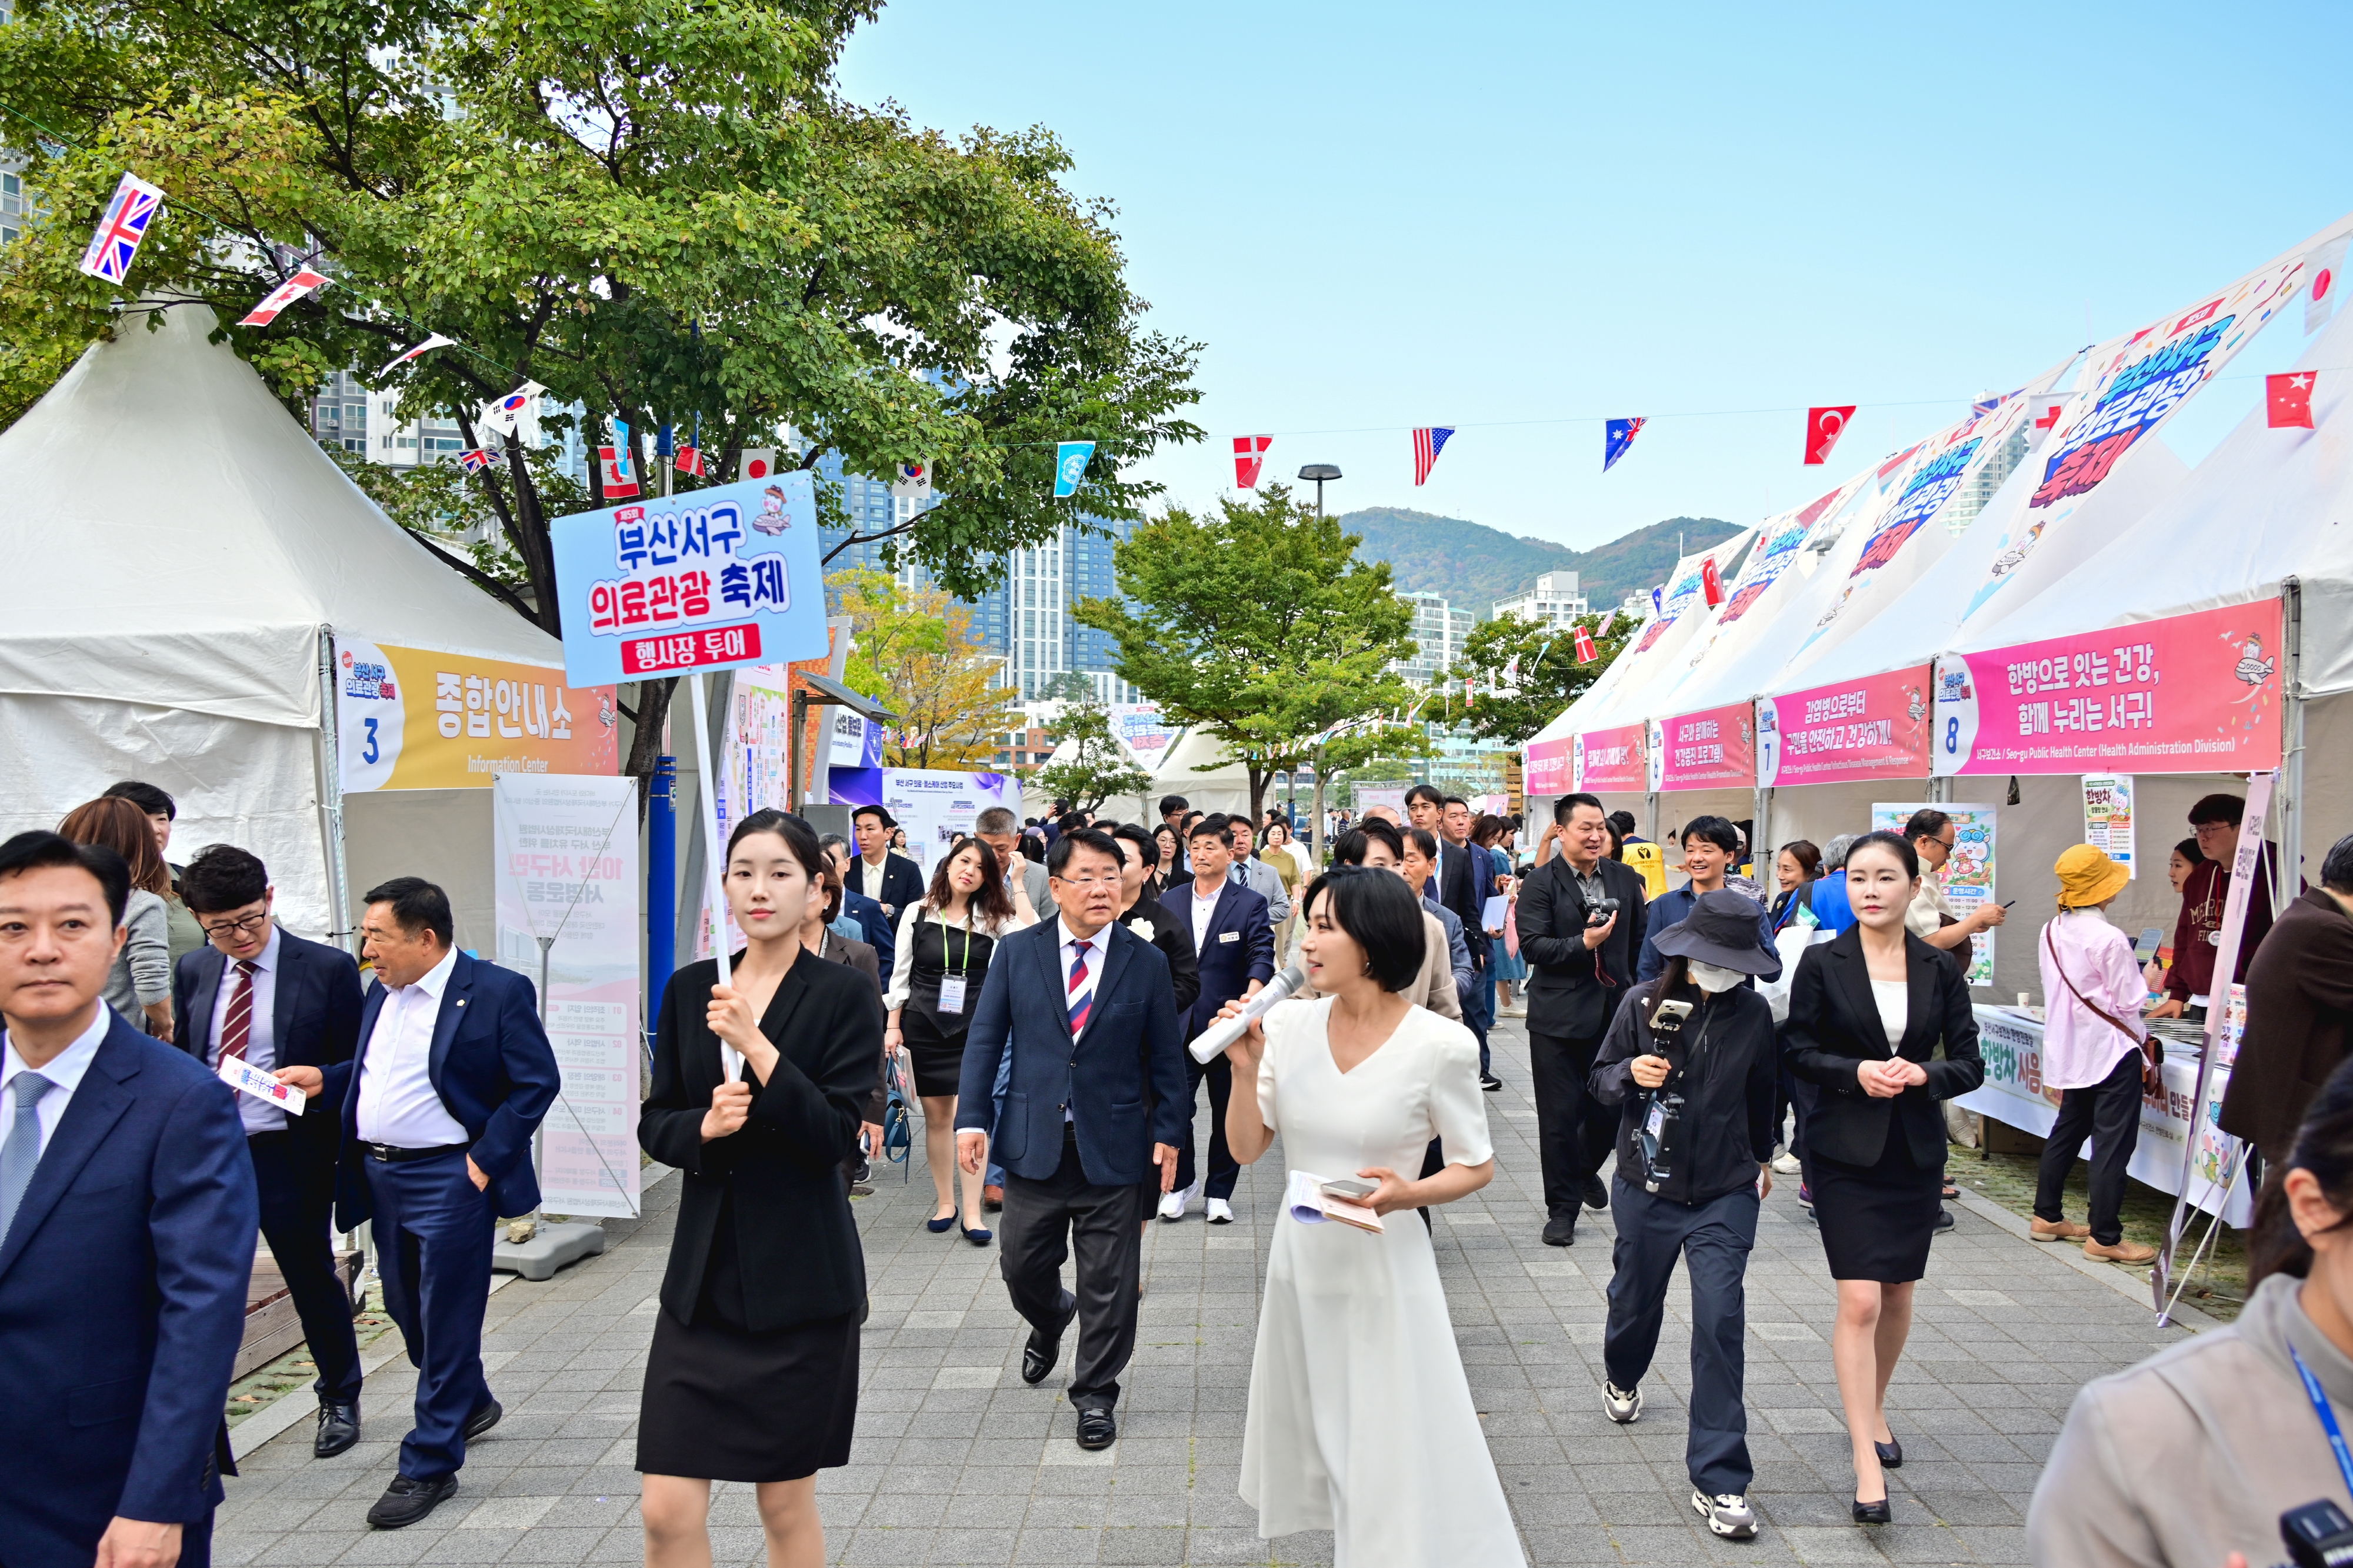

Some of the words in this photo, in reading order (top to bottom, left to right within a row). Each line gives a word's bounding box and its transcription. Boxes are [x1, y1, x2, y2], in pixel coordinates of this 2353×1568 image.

[2182, 305, 2215, 328] 제5회
[2098, 314, 2236, 404] 부산서구
[2053, 361, 2210, 459] 의료관광
[1900, 436, 1983, 499] 부산서구
[2029, 425, 2142, 508] 축제
[620, 509, 639, 521] 제5회
[1869, 474, 1964, 542] 의료관광
[620, 508, 741, 569] 부산서구
[1849, 518, 1920, 579] 축제
[591, 571, 711, 628] 의료관광
[721, 560, 785, 608] 축제
[635, 637, 696, 669] 행사장
[704, 629, 746, 660] 투어
[354, 662, 370, 680] 부산
[371, 664, 386, 680] 서구
[2007, 655, 2071, 696] 한방으로
[2073, 650, 2109, 688] 잇는
[2113, 643, 2159, 685] 건강,
[346, 678, 379, 699] 의료관광
[379, 683, 395, 700] 축제
[436, 671, 572, 740] 종합안내소
[1805, 689, 1866, 725] 감염병으로부터
[847, 715, 861, 738] 홍보관
[1678, 723, 1695, 743] 서구와
[1695, 719, 1718, 741] 함께하는
[2018, 702, 2050, 736] 함께
[2053, 698, 2104, 734] 누리는
[2107, 691, 2153, 730] 서구!
[362, 718, 379, 764] 3
[1787, 732, 1808, 756] 구민을
[1809, 725, 1845, 753] 안전하고
[1846, 719, 1892, 749] 건강하게!
[1946, 716, 1959, 754] 8
[1977, 748, 2001, 760] 서구보건소
[2006, 748, 2028, 763] Seo-gu
[2029, 746, 2049, 759] Public
[2050, 746, 2072, 758] Health
[2074, 745, 2097, 758] Center
[2098, 743, 2127, 757] (Health
[2128, 739, 2192, 756] Administration
[2194, 736, 2235, 753] Division)
[468, 755, 521, 773] Information
[522, 756, 548, 773] Center
[1576, 764, 1580, 782] 5
[1654, 757, 1658, 779] 6
[1675, 747, 1696, 768] 건강증진
[1698, 743, 1723, 764] 프로그램!
[1765, 743, 1771, 770] 7
[1848, 759, 1861, 768] Disease
[1861, 758, 1885, 769] Management
[1889, 756, 1909, 767] Response
[2086, 788, 2111, 805] 한방차
[1952, 887, 1977, 895] 운영시간
[1984, 1021, 2011, 1039] 부산서구보건소
[1981, 1036, 2017, 1085] 한방차
[2017, 1052, 2041, 1095] 시음
